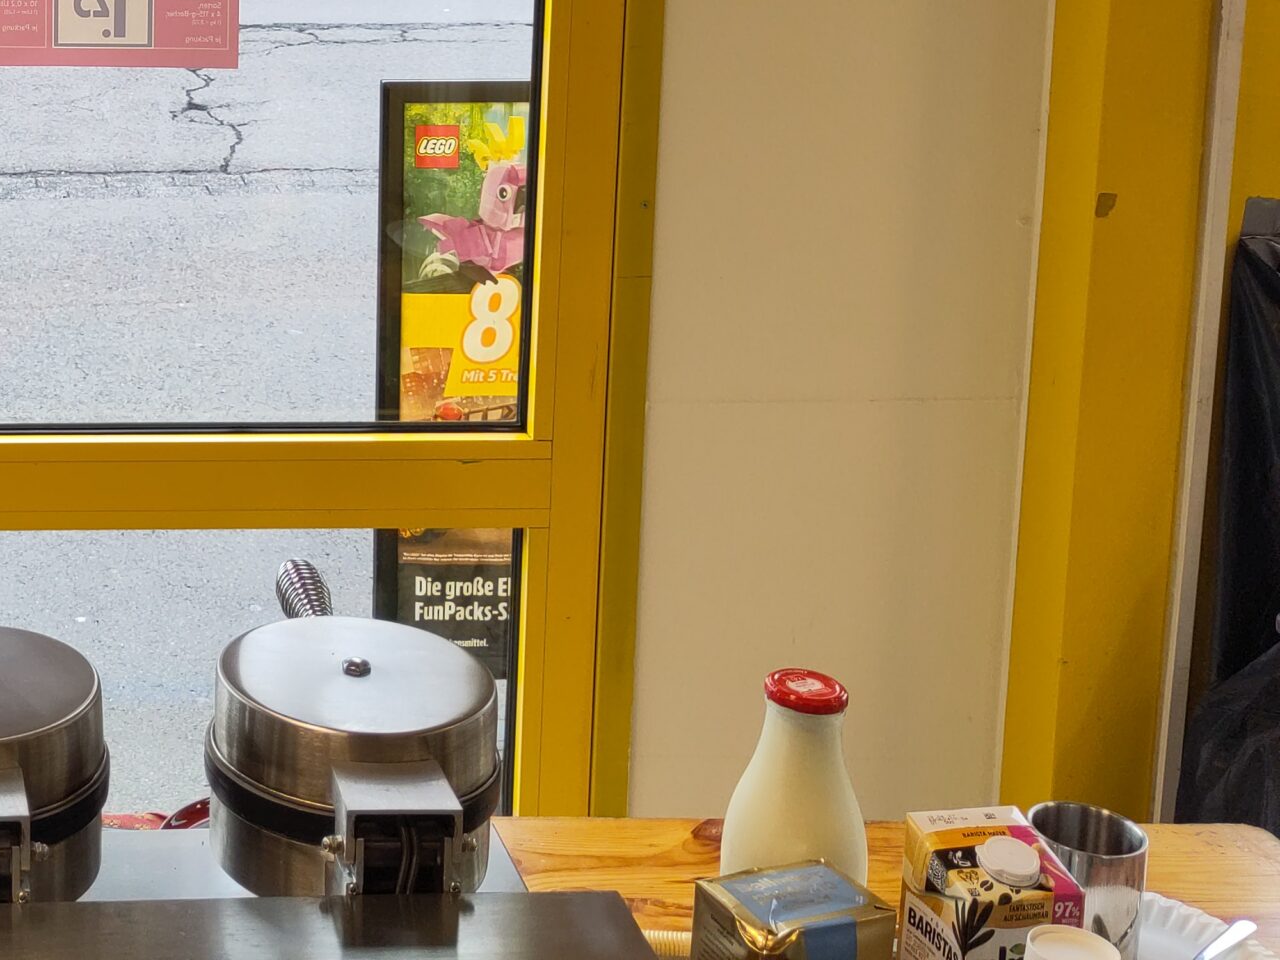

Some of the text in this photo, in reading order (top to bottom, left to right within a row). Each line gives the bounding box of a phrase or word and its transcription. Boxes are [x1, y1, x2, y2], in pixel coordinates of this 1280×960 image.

[418, 137, 457, 155] LEGO
[462, 370, 485, 383] Mit
[487, 370, 497, 383] 5
[415, 576, 441, 596] Die
[445, 576, 494, 600] große
[414, 601, 511, 621] FunPacks-S
